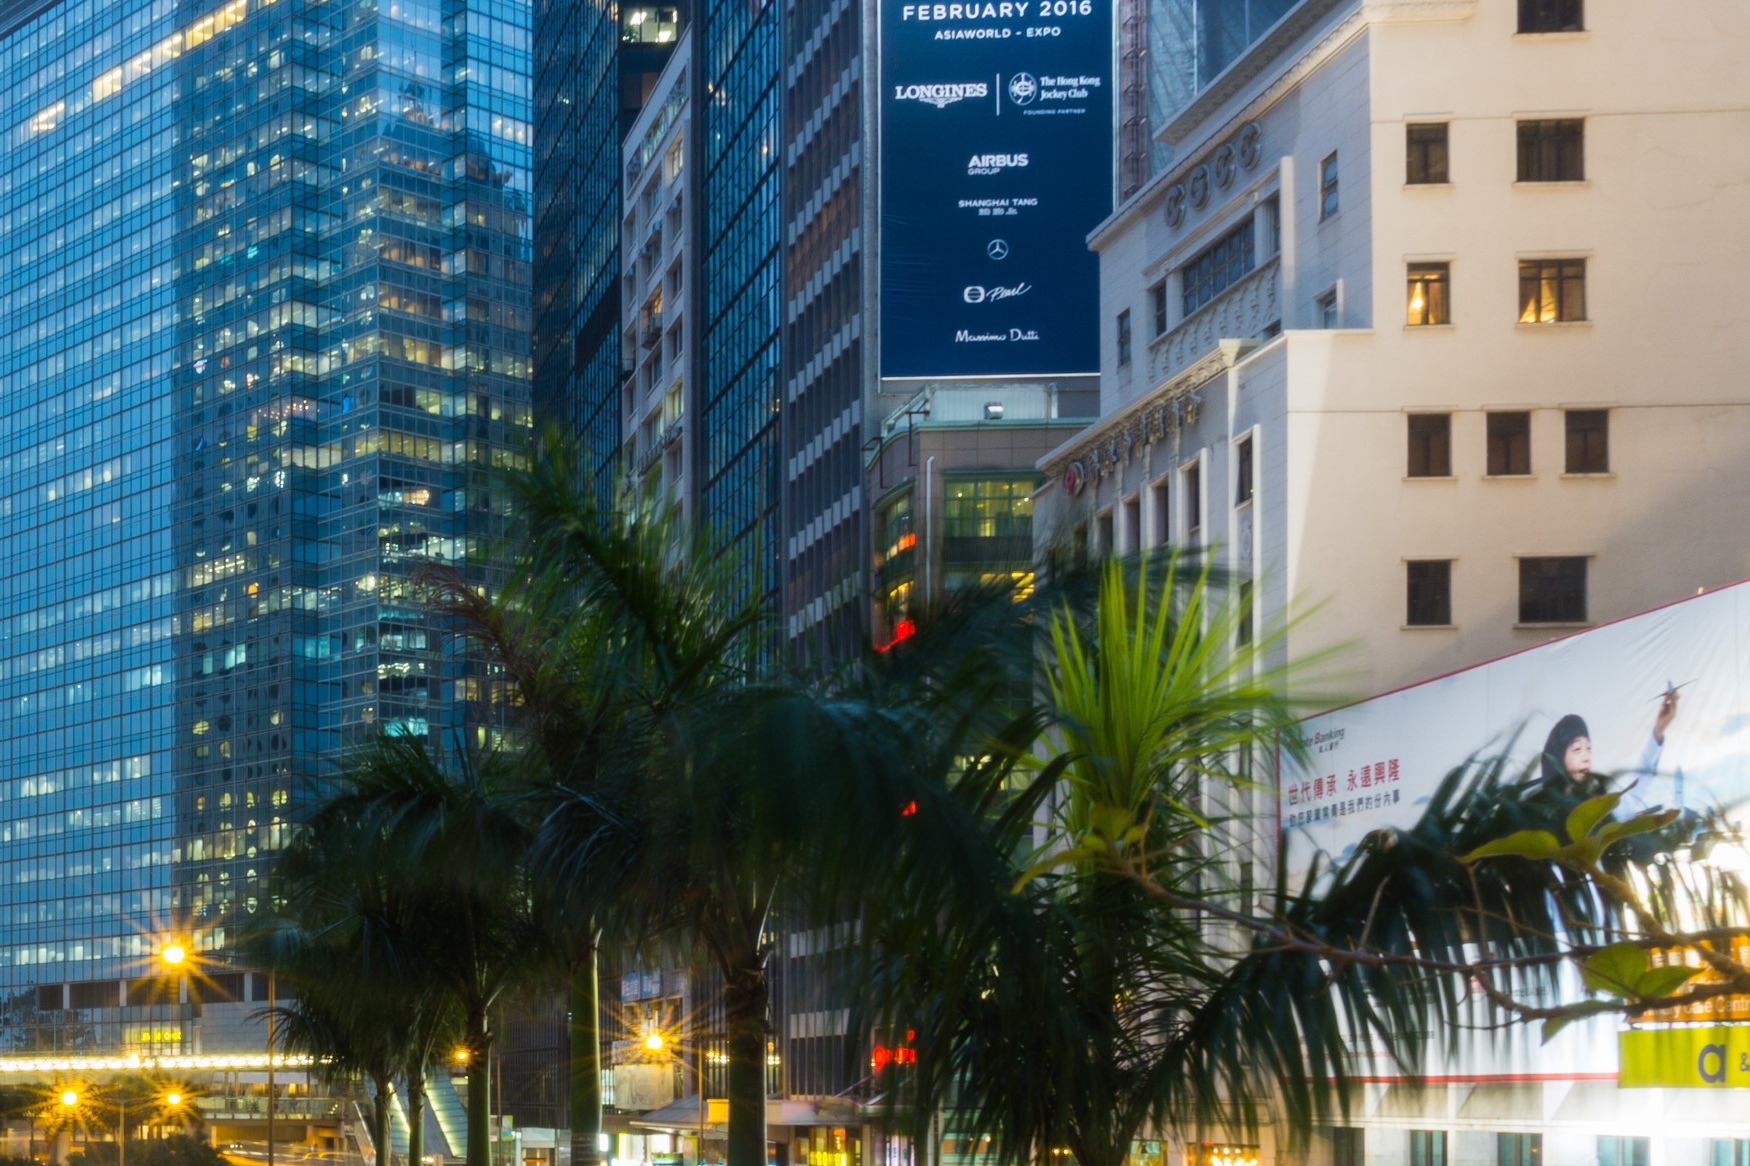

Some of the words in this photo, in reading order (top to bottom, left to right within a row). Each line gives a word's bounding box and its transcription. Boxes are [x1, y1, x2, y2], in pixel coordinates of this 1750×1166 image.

[902, 1, 1028, 21] FEBRUARY
[1040, 0, 1092, 17] 2016
[934, 28, 1011, 41] ASIAWORLD
[1026, 26, 1062, 38] EXPO
[1040, 76, 1056, 87] The
[1056, 76, 1079, 88] Hong
[1079, 75, 1101, 88] Kong
[895, 83, 988, 99] LONGINES
[1040, 89, 1068, 101] Jockey
[1067, 86, 1089, 99] Club
[968, 153, 1029, 168] AIRBUS
[967, 167, 1001, 176] GROUP
[958, 199, 1010, 208] SHANGHAI
[1012, 198, 1038, 206] TANG
[955, 329, 1007, 342] Massimo
[1010, 328, 1039, 341] Dutti
